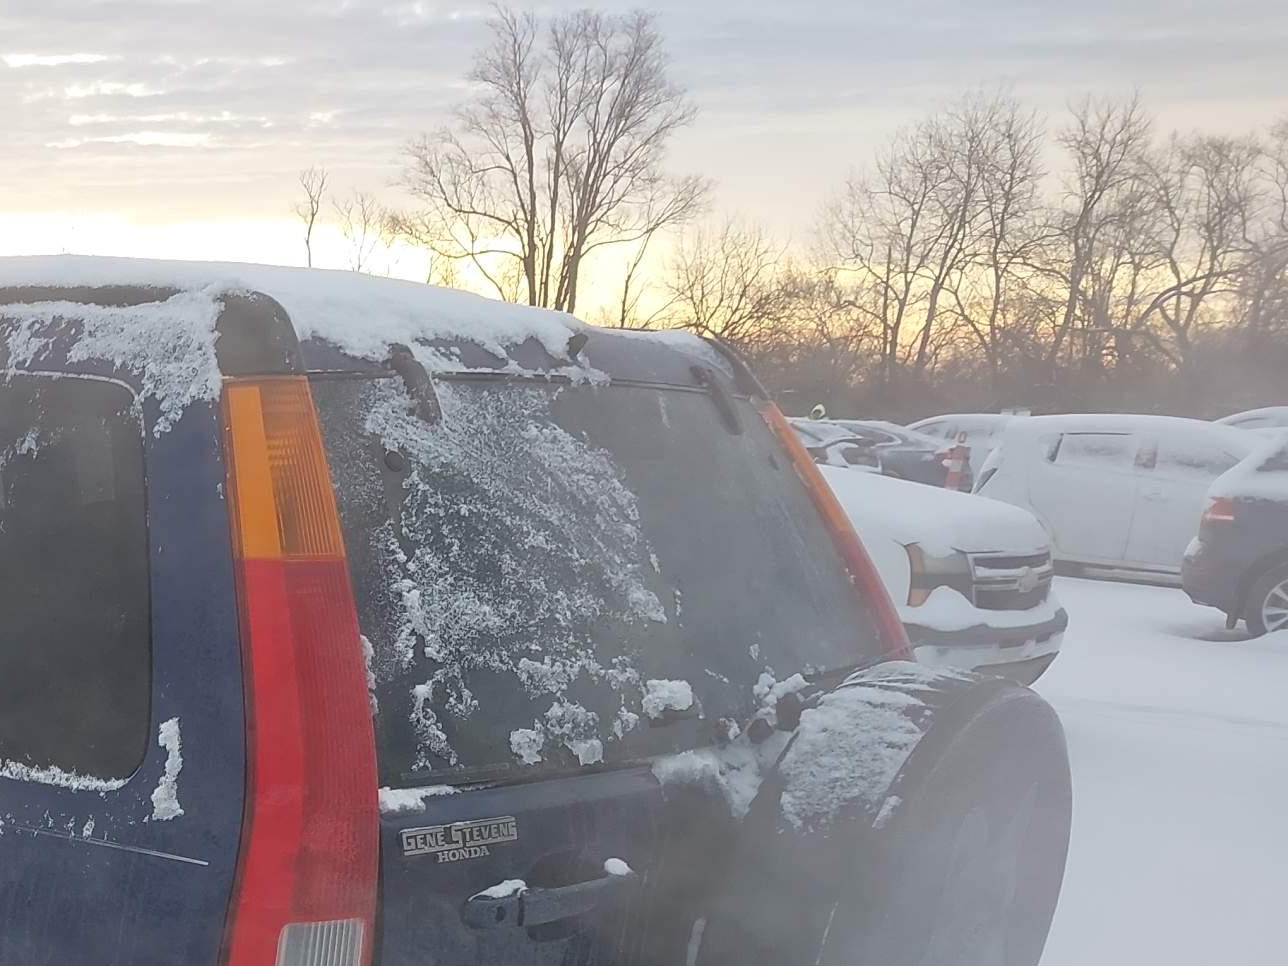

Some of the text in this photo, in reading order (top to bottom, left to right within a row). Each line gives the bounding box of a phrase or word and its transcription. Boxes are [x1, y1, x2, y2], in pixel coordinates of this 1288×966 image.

[402, 819, 518, 852] GENE STEVENS
[436, 845, 491, 864] HONDA
